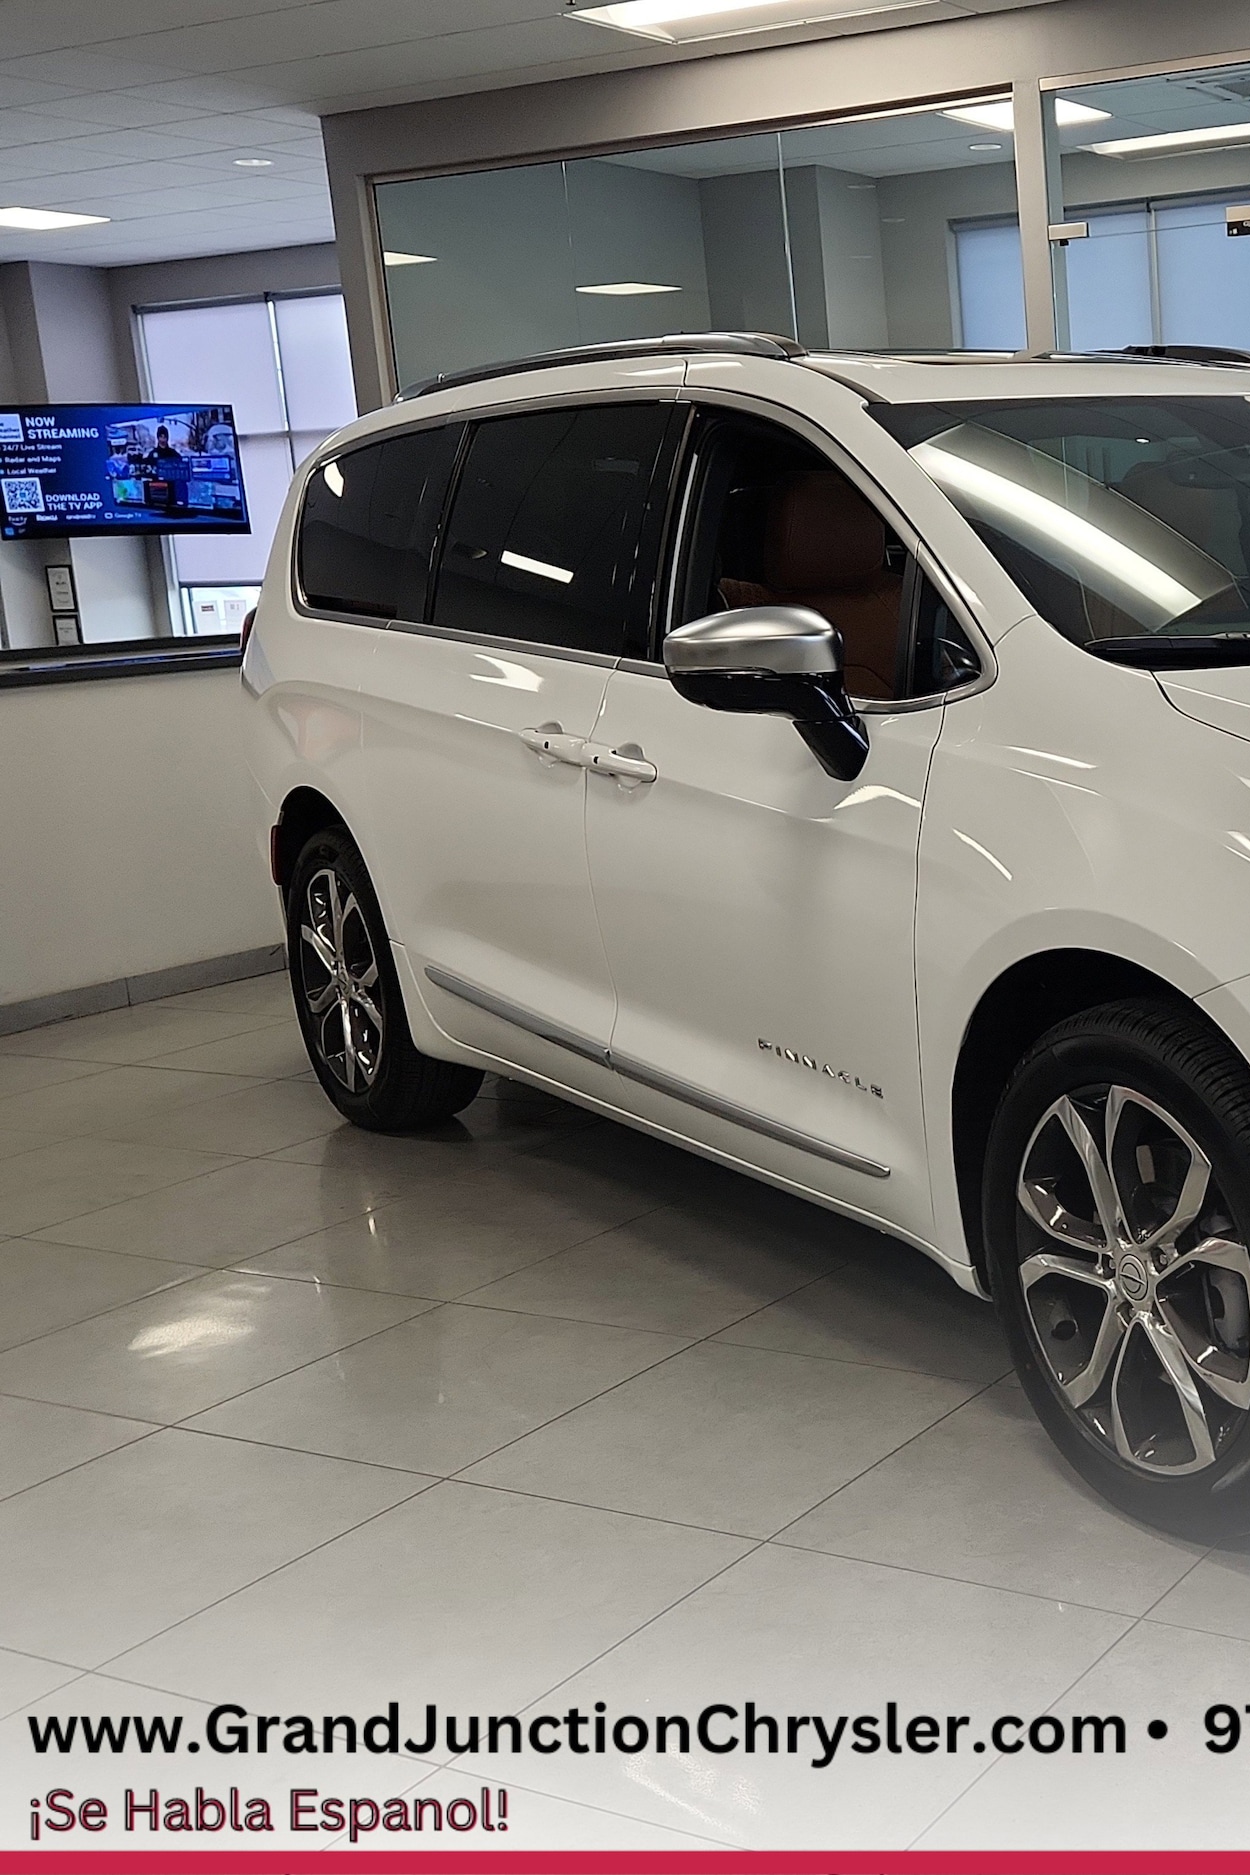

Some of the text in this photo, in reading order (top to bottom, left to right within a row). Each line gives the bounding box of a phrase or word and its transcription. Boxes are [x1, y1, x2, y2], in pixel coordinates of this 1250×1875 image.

[25, 416, 56, 428] NOW
[27, 428, 100, 440] STREAMING
[45, 493, 100, 502] DOWNLOAD
[47, 502, 103, 511] THE TV APP
[758, 1038, 884, 1099] PINNACLE
